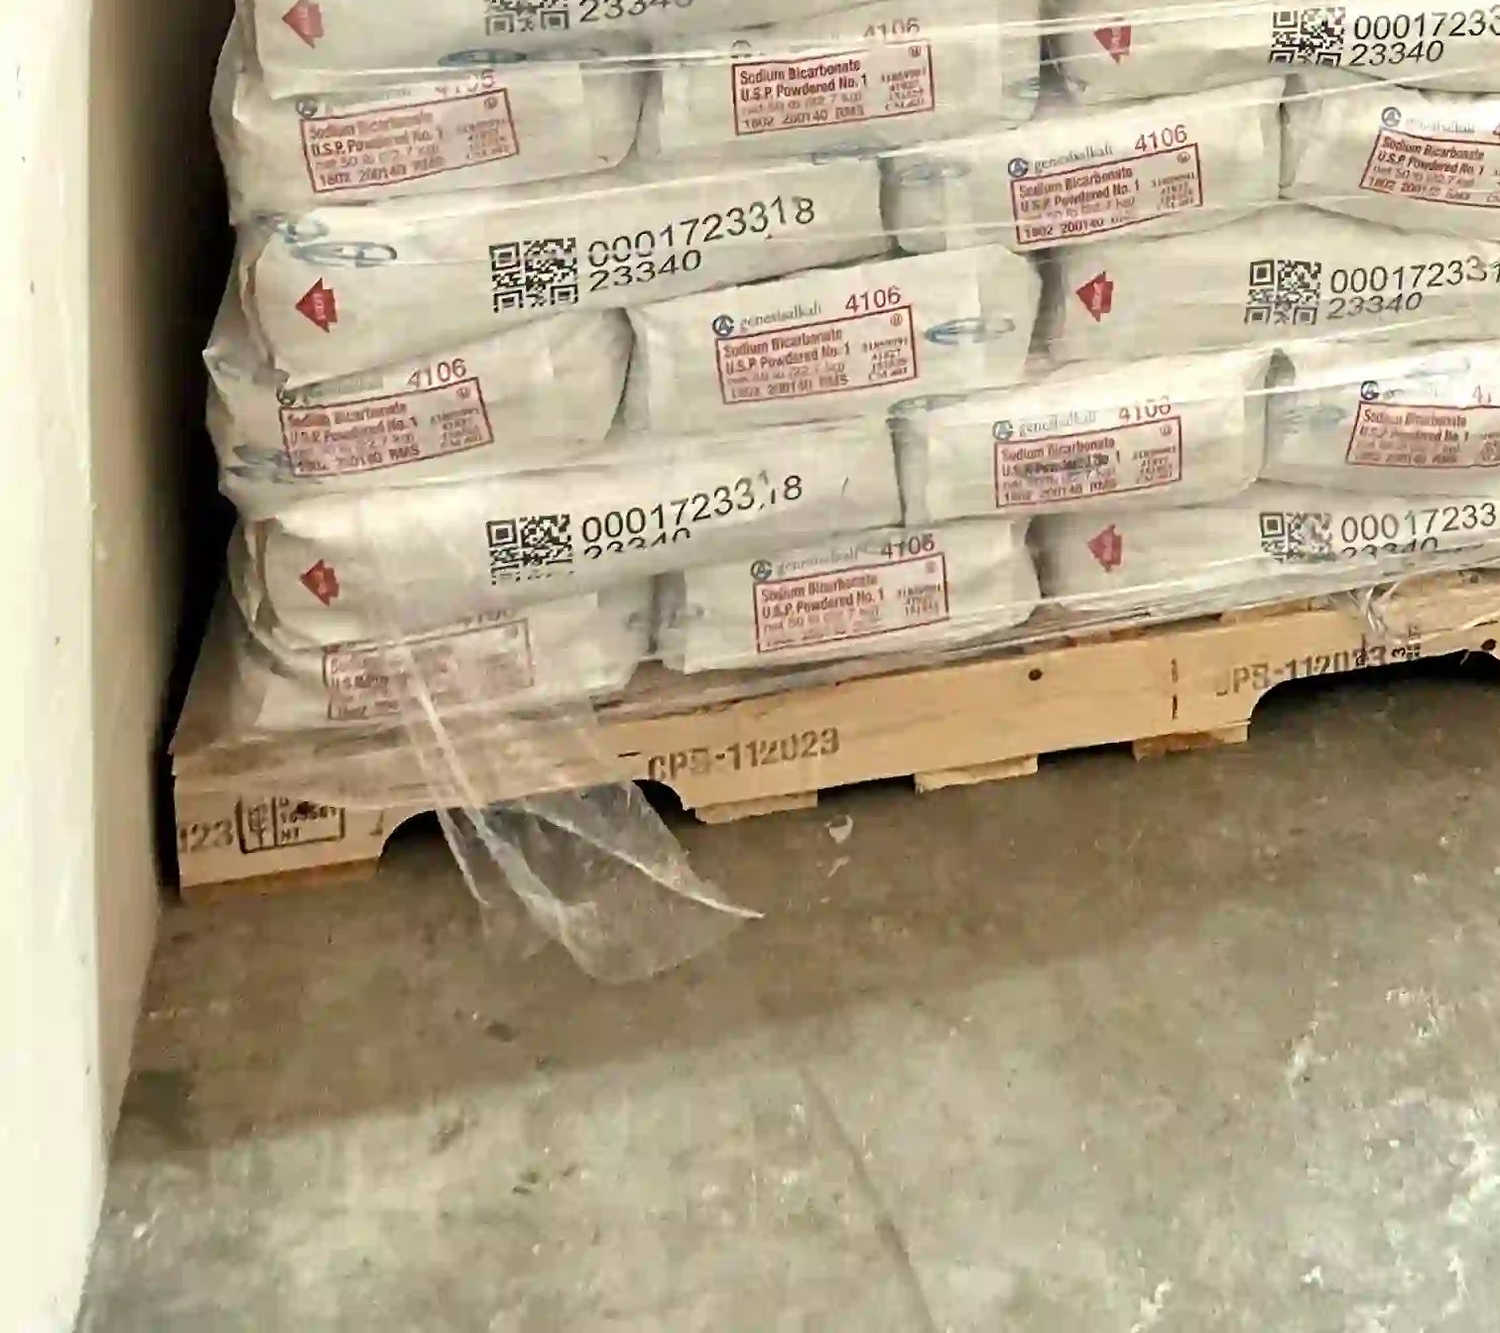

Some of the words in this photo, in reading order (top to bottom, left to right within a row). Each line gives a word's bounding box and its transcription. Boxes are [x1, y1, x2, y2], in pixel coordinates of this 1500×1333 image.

[1349, 40, 1444, 66] 23340
[740, 67, 785, 85] Sodium
[788, 59, 861, 80] Bicarbonate
[776, 78, 835, 98] Powdered
[839, 76, 859, 89] No.
[861, 73, 868, 87] 1
[311, 140, 346, 156] U.S.P.
[1135, 124, 1188, 152] 4106
[1382, 136, 1422, 154] Sodium
[1424, 145, 1485, 161] Bicarbonate
[1377, 153, 1405, 163] U.S.P.
[1407, 156, 1458, 174] Powdered
[1065, 166, 1133, 191] Bicarbonate
[1135, 179, 1140, 191] 1
[588, 195, 814, 267] 0001723318
[589, 249, 702, 293] 23340
[845, 285, 901, 313] 4106
[1327, 292, 1423, 320] 23340
[724, 342, 769, 358] Sodium
[772, 329, 843, 351] Bicarbonate
[761, 349, 818, 368] Powdered
[844, 343, 850, 355] 1
[407, 358, 466, 388] 4106
[1119, 396, 1171, 422] 4106
[582, 470, 802, 543] 0001723318
[881, 533, 936, 559] 4106
[879, 590, 884, 601] 1
